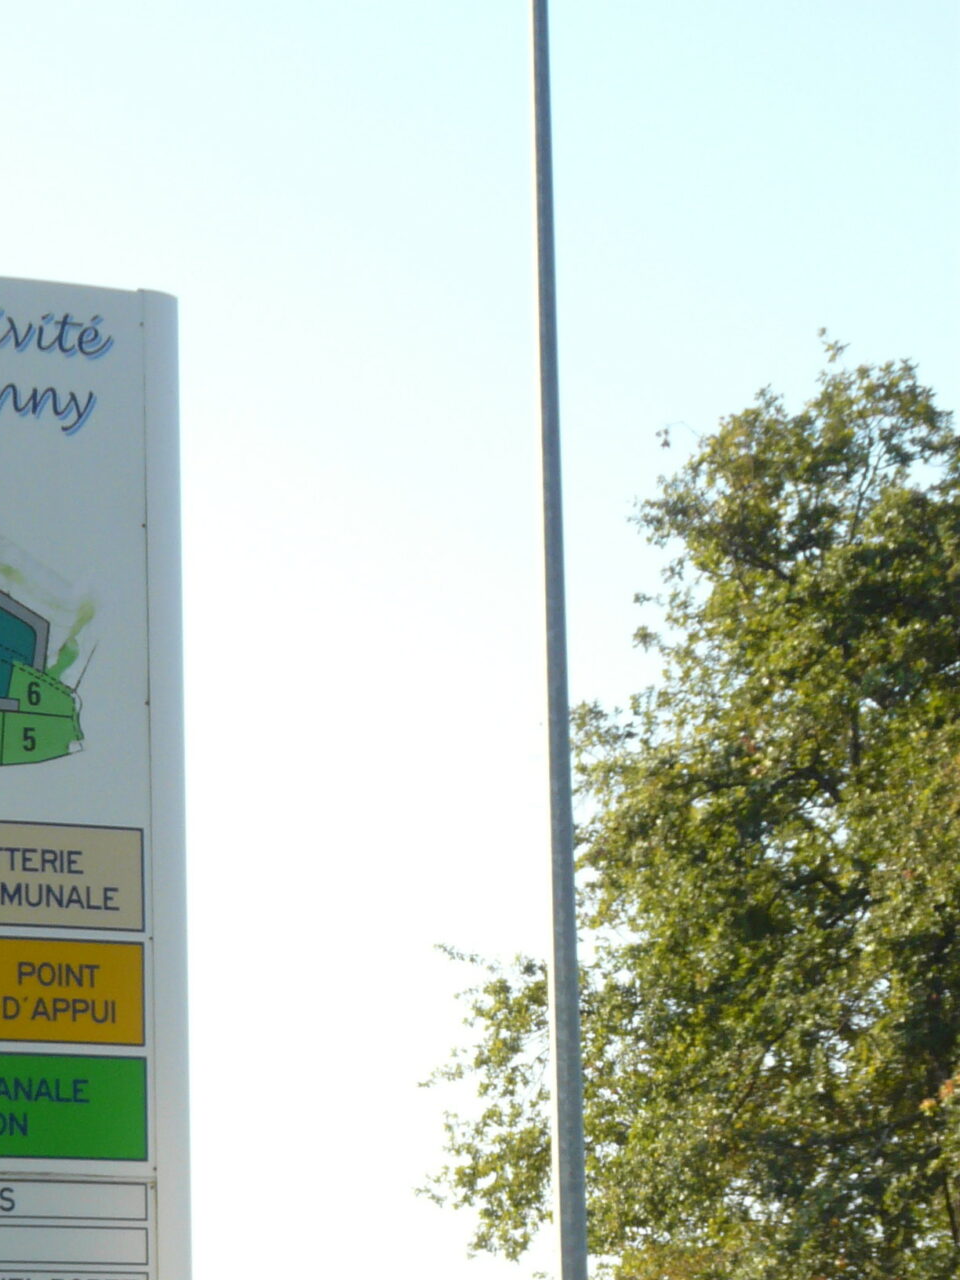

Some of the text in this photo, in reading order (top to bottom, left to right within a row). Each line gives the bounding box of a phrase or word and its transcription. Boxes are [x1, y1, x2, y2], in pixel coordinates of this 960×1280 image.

[26, 680, 41, 706] 6
[22, 726, 37, 752] 5
[16, 961, 100, 988] POINT
[1, 996, 117, 1024] D'APPUI
